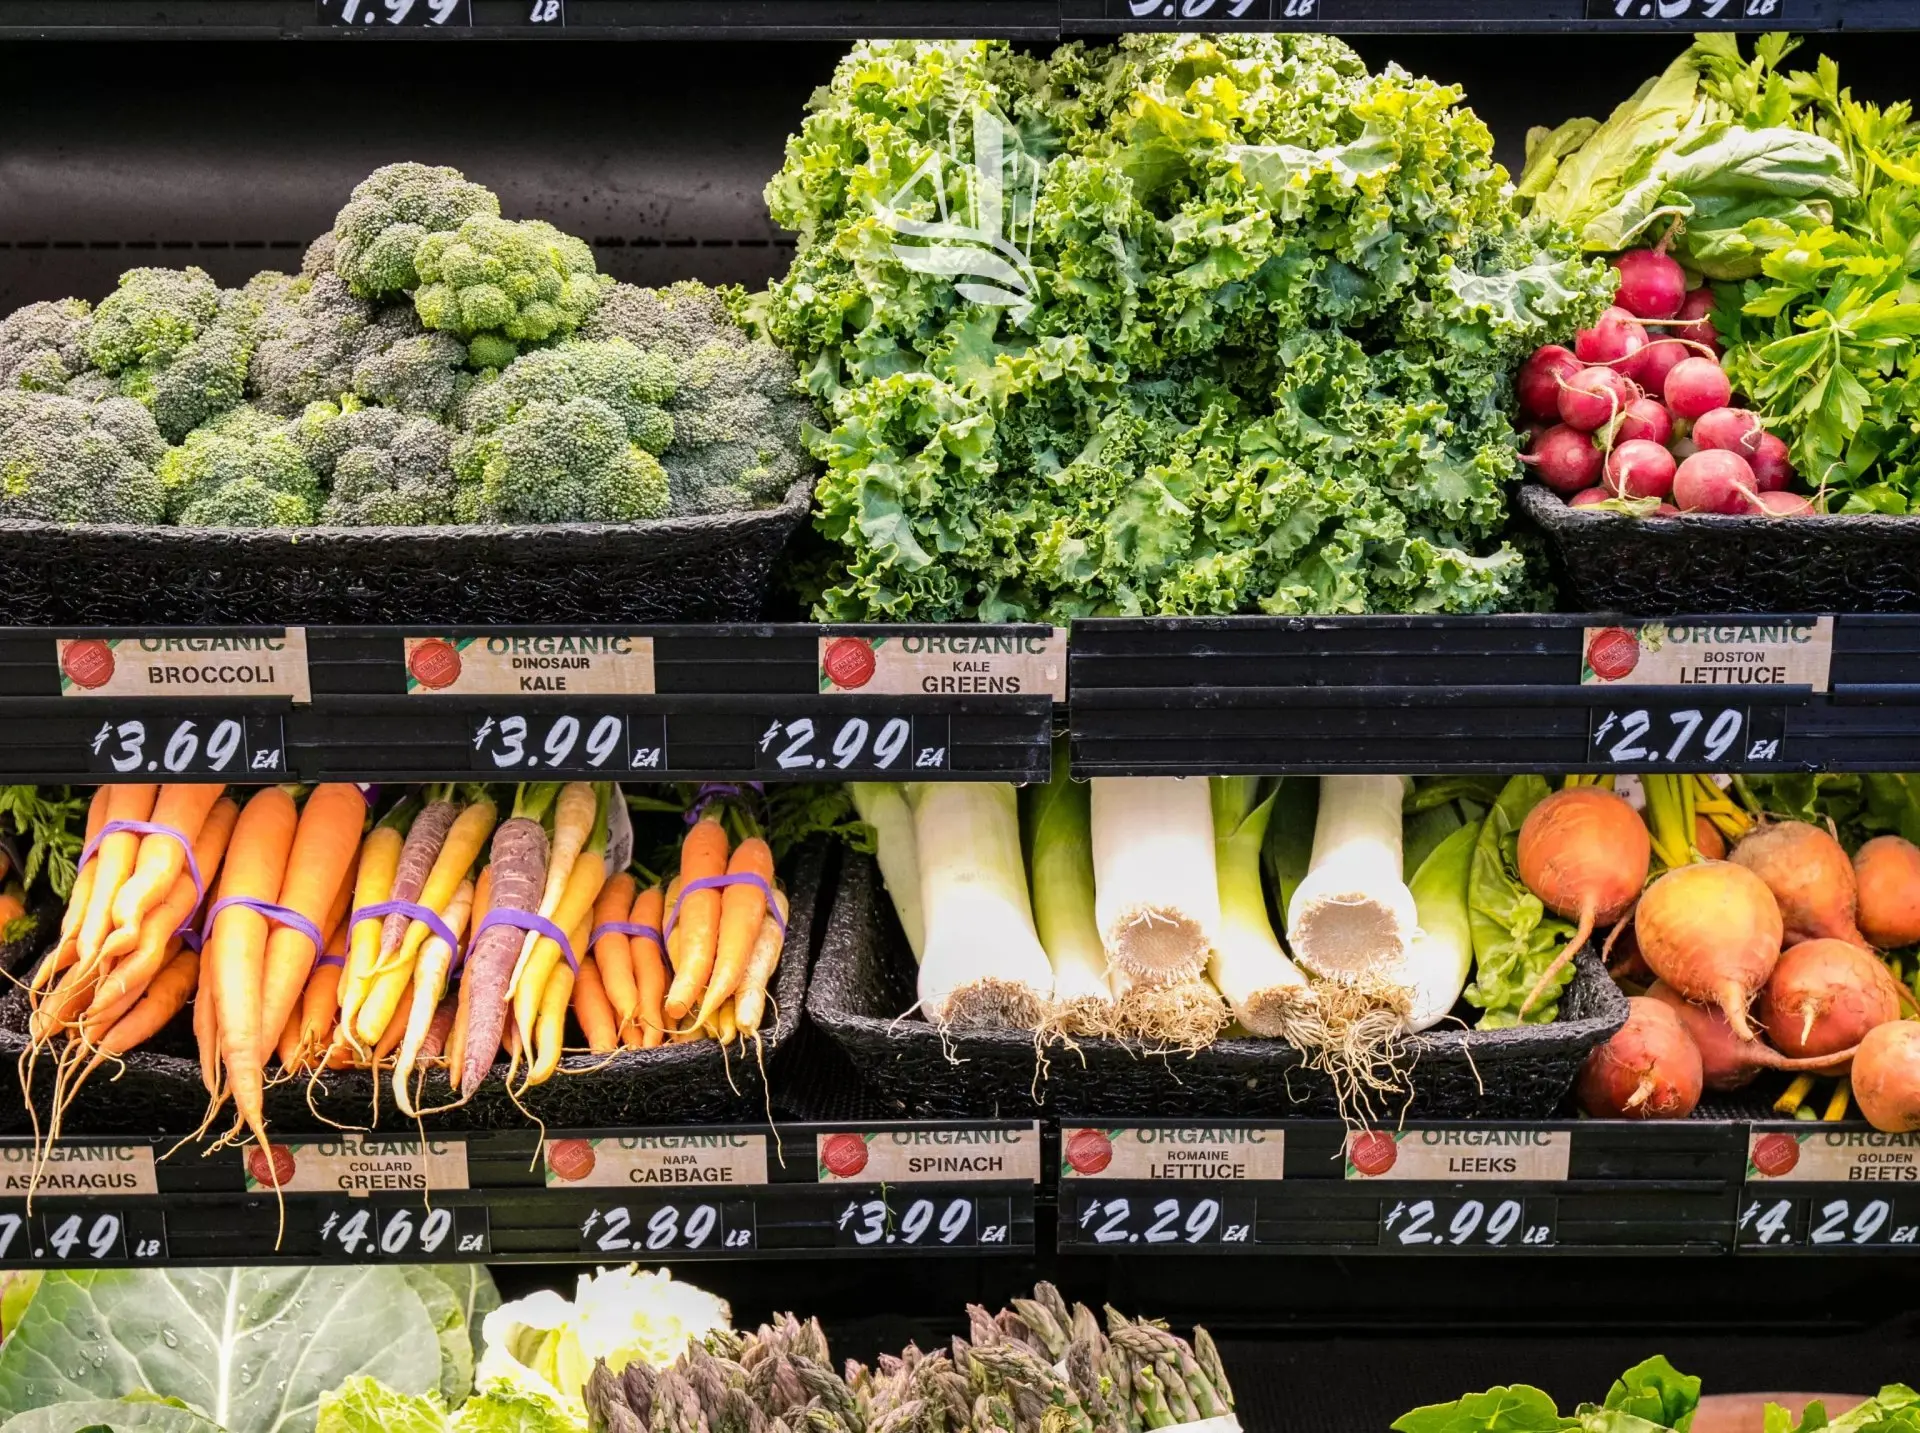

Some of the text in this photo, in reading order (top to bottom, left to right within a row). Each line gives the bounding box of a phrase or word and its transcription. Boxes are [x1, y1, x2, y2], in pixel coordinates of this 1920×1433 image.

[1667, 626, 1812, 644] ORGANIC
[139, 638, 284, 651] ORGANIC
[486, 636, 632, 655] ORGANIC
[902, 636, 1047, 655] ORGANIC
[512, 657, 590, 669] DINOSAUR
[1703, 651, 1765, 663] BOSTON
[148, 666, 275, 683] BROCCOLI
[953, 661, 990, 672] KALE
[1680, 666, 1786, 684] LETTUCE
[519, 676, 566, 691] KALE
[922, 676, 1021, 693] GREENS
[472, 715, 661, 768] $3.99 EA
[758, 717, 945, 770] $2.99 EA
[1593, 708, 1780, 763] $2.79 EA
[91, 719, 280, 772] $3.69 EA
[617, 1135, 749, 1150] ORGANIC
[891, 1130, 1022, 1145] ORGANIC
[1136, 1128, 1266, 1145] ORGANIC
[1421, 1130, 1552, 1147] ORGANIC
[663, 1155, 697, 1165] NAPA
[908, 1156, 1003, 1173] SPINACH
[1167, 1151, 1229, 1161] ROMAINE
[1857, 1153, 1913, 1163] GOLDEN
[350, 1162, 412, 1172] COLLARD
[1150, 1163, 1245, 1179] LETTUCE
[1449, 1157, 1517, 1173] LEEKS
[1849, 1166, 1918, 1181] BEETS
[5, 1173, 137, 1189] ASPARAGUS
[338, 1174, 427, 1189] GREENS
[629, 1167, 733, 1183] CABBAGE
[580, 1204, 751, 1251] $2.89 LB
[836, 1199, 1008, 1245] $3.99 EA
[1079, 1198, 1250, 1244] $2.29 EA
[1383, 1200, 1550, 1245] $2.99 LB
[319, 1208, 484, 1254] $4.69 EA
[1890, 1225, 1920, 1243] EA
[135, 1239, 160, 1257] LB
